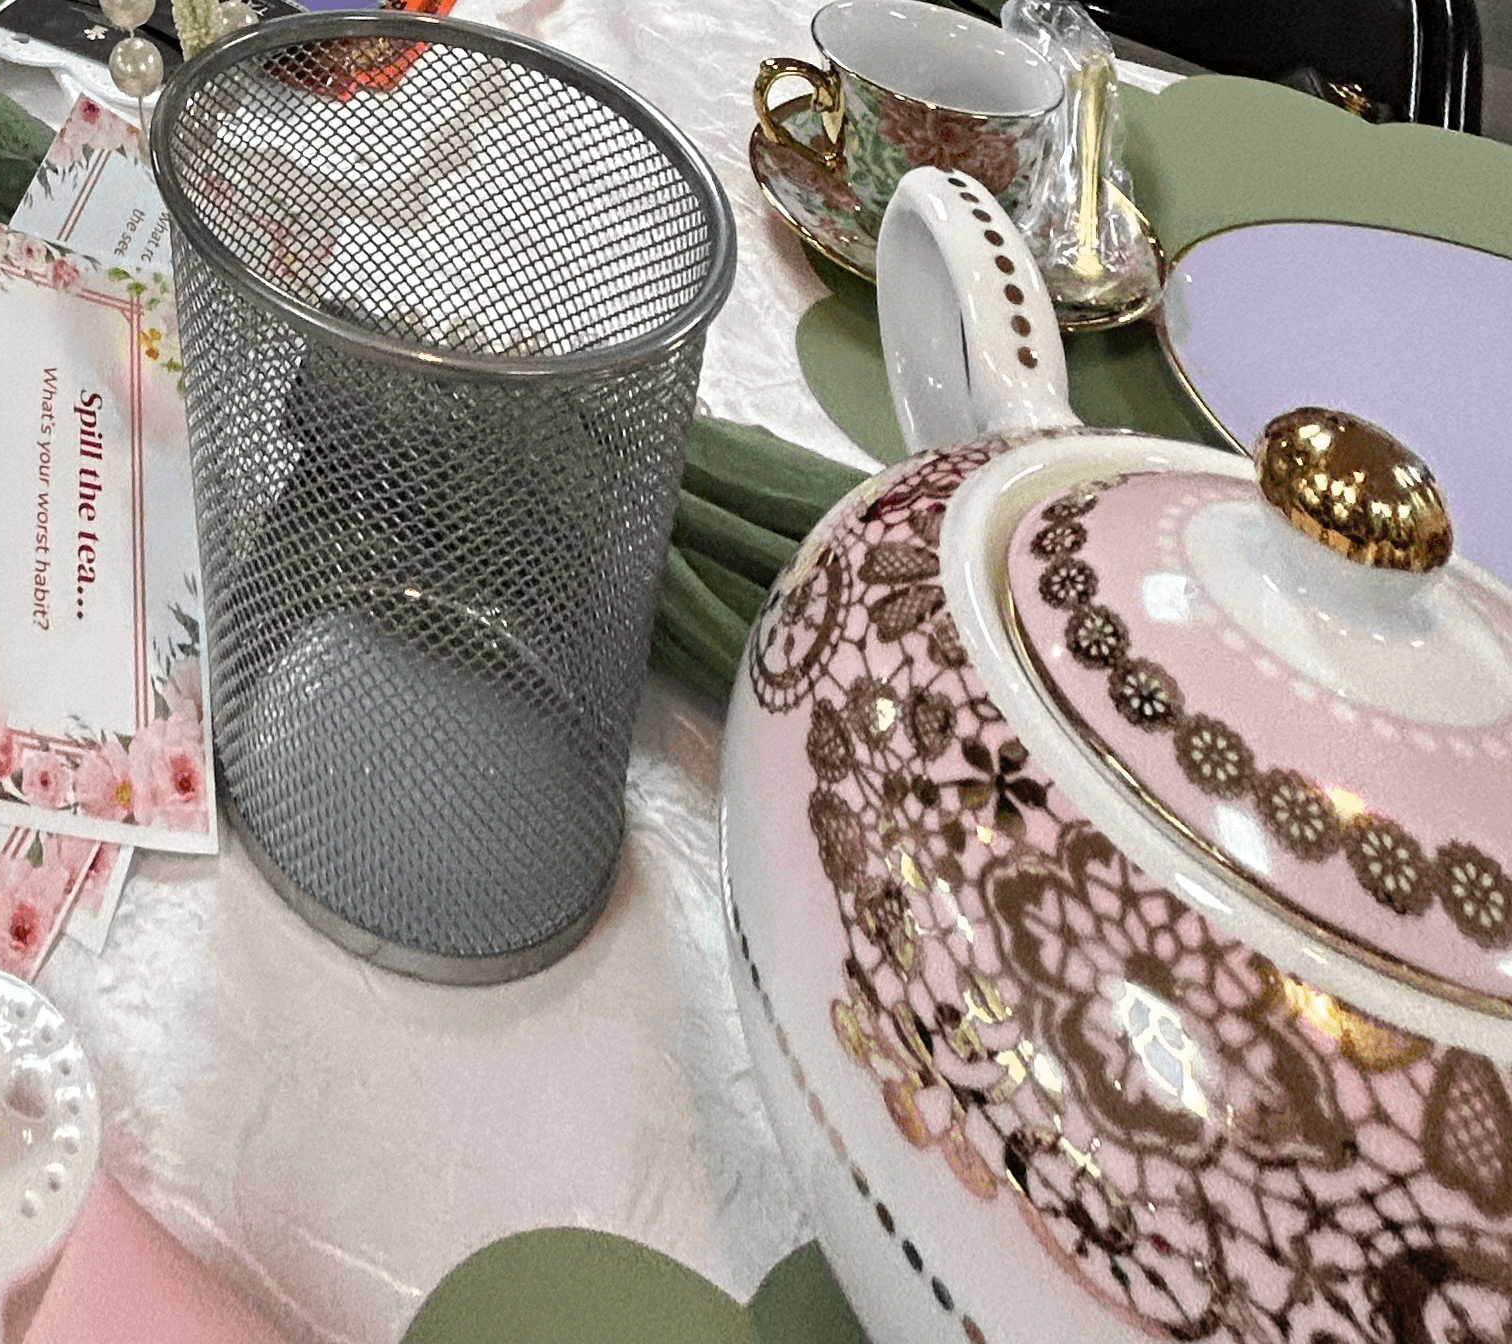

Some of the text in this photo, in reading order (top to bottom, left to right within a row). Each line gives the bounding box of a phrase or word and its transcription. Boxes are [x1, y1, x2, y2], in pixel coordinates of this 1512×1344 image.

[127, 208, 147, 233] the
[33, 367, 58, 632] What's your worst habit?
[74, 389, 103, 620] Spill the tea...
